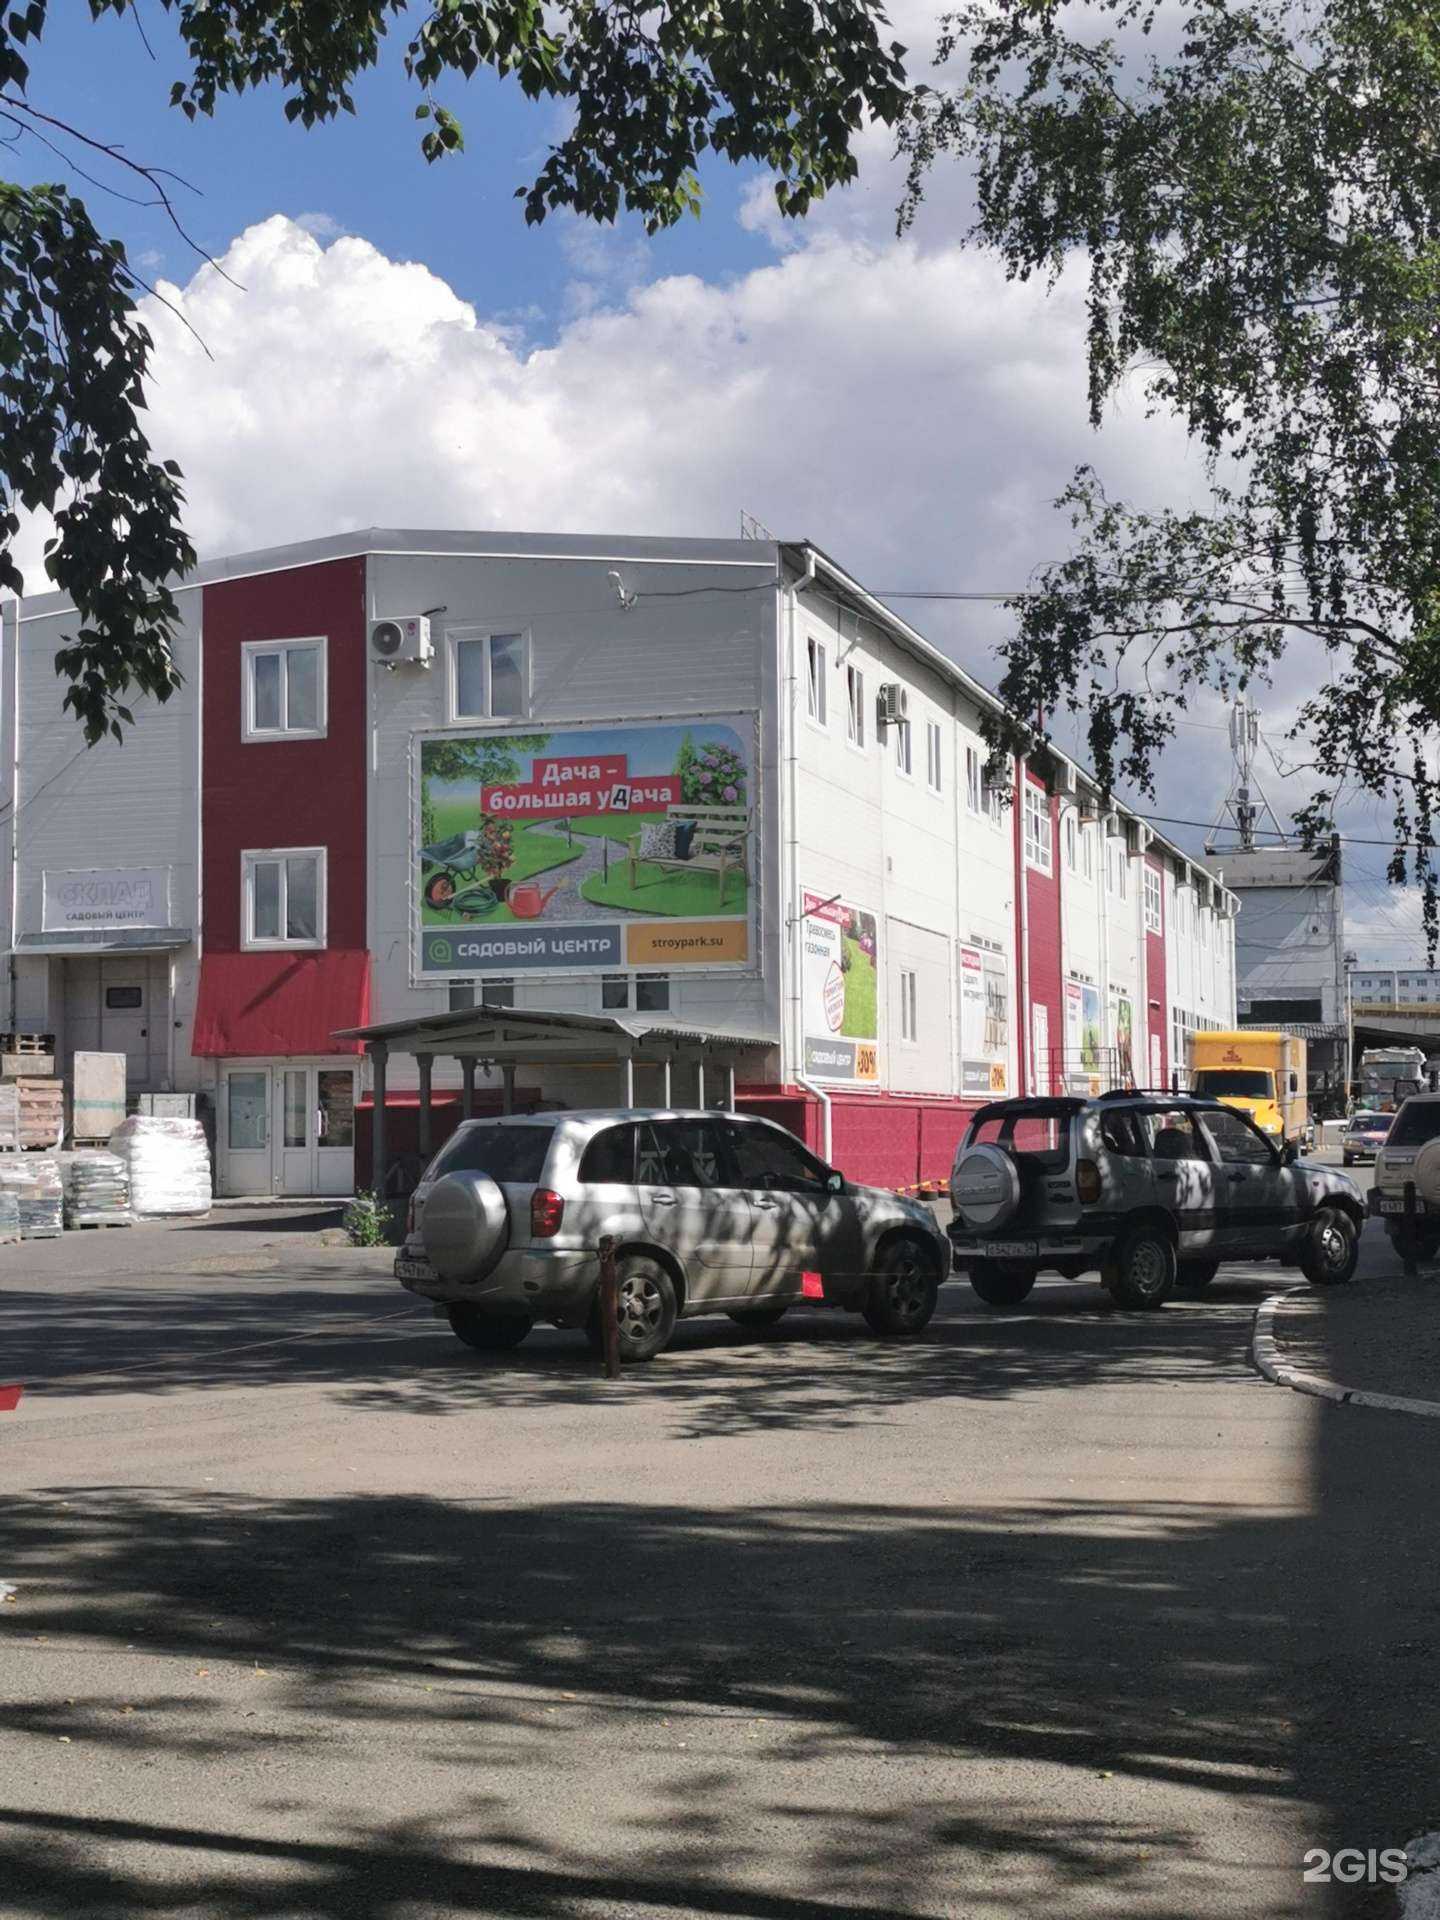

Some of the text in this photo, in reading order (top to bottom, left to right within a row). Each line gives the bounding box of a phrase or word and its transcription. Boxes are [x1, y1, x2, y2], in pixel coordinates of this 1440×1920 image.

[541, 762, 601, 787] Дача
[489, 789, 591, 811] большая
[58, 880, 154, 908] СКЛАД
[66, 910, 145, 921] САДОВЫЙ ЦЕНТР
[457, 937, 612, 957] САДОВЫЙ ЦЕНТР
[651, 934, 723, 951] stroypark.su
